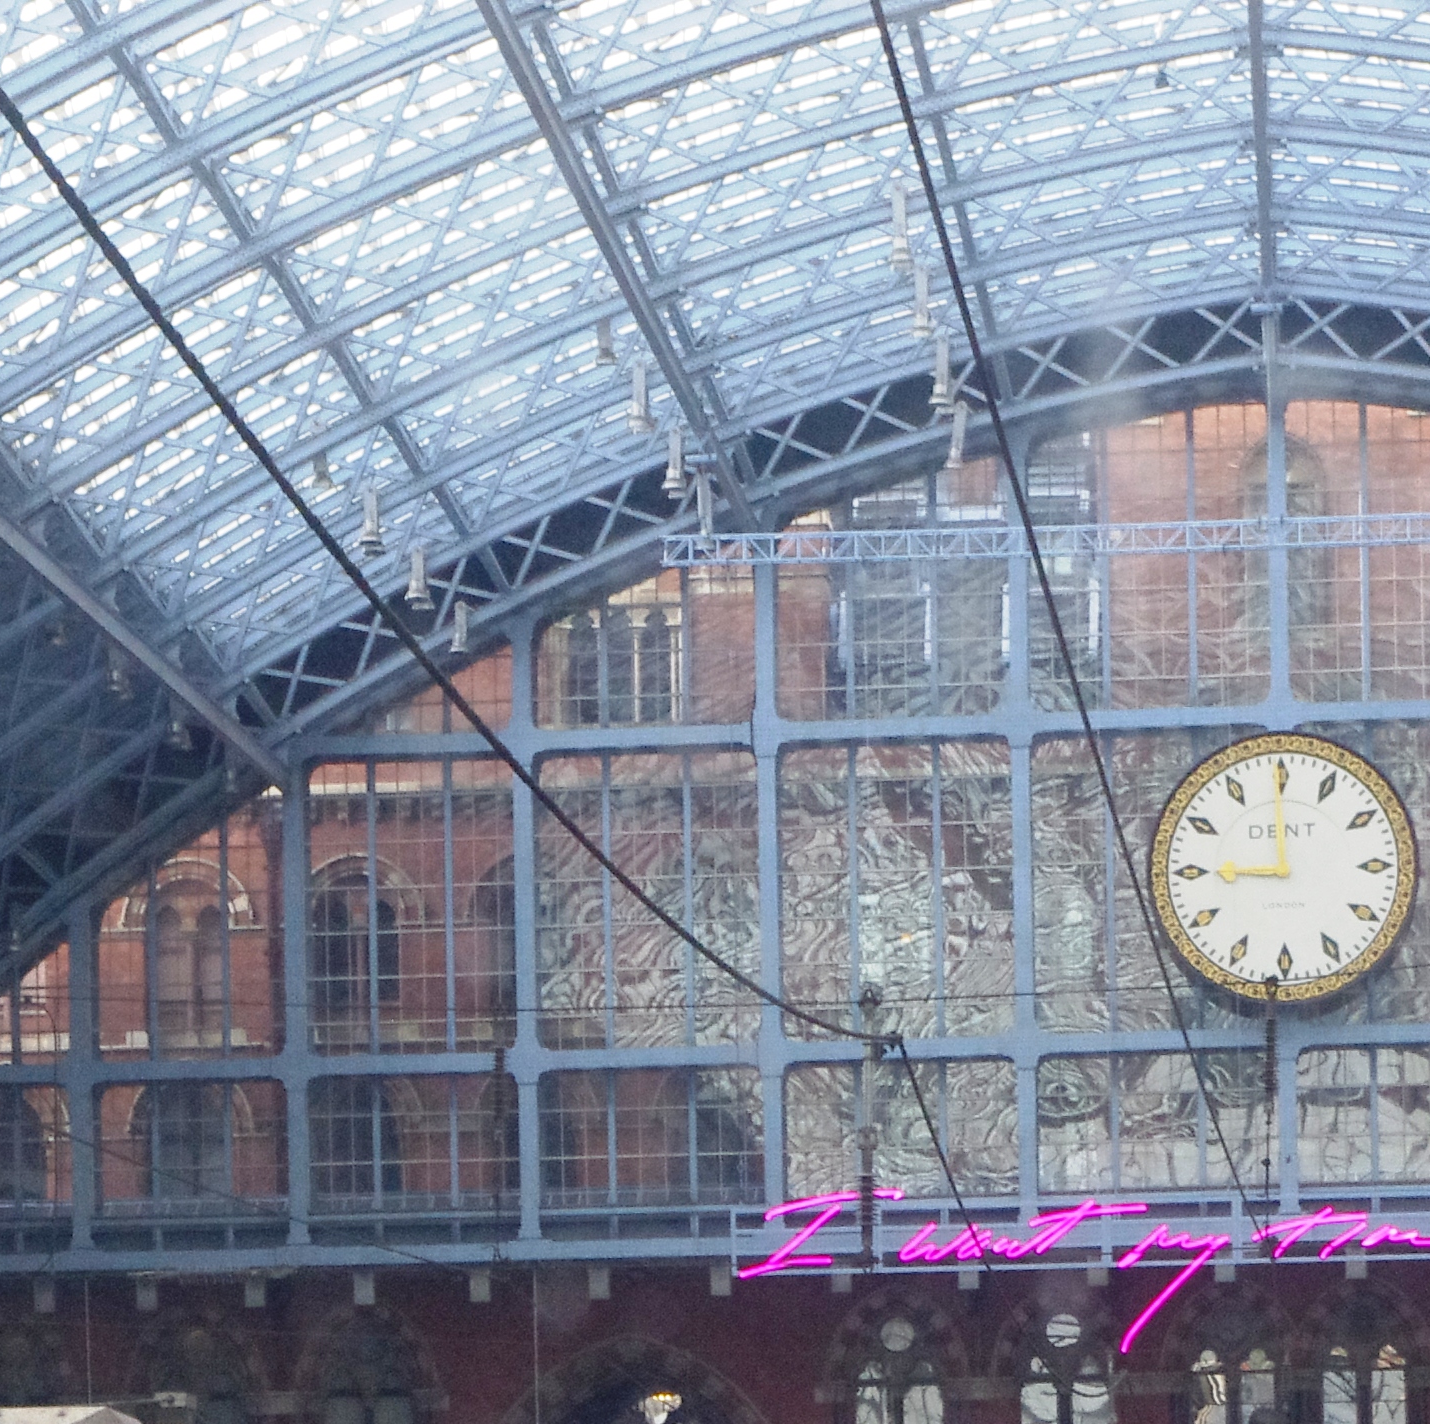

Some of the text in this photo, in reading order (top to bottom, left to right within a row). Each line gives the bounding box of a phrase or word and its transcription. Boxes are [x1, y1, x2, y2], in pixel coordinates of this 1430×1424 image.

[1248, 823, 1315, 839] DENT
[1262, 902, 1305, 910] LONDON
[739, 1189, 904, 1279] I
[899, 1200, 1148, 1262] want
[1117, 1223, 1231, 1354] my
